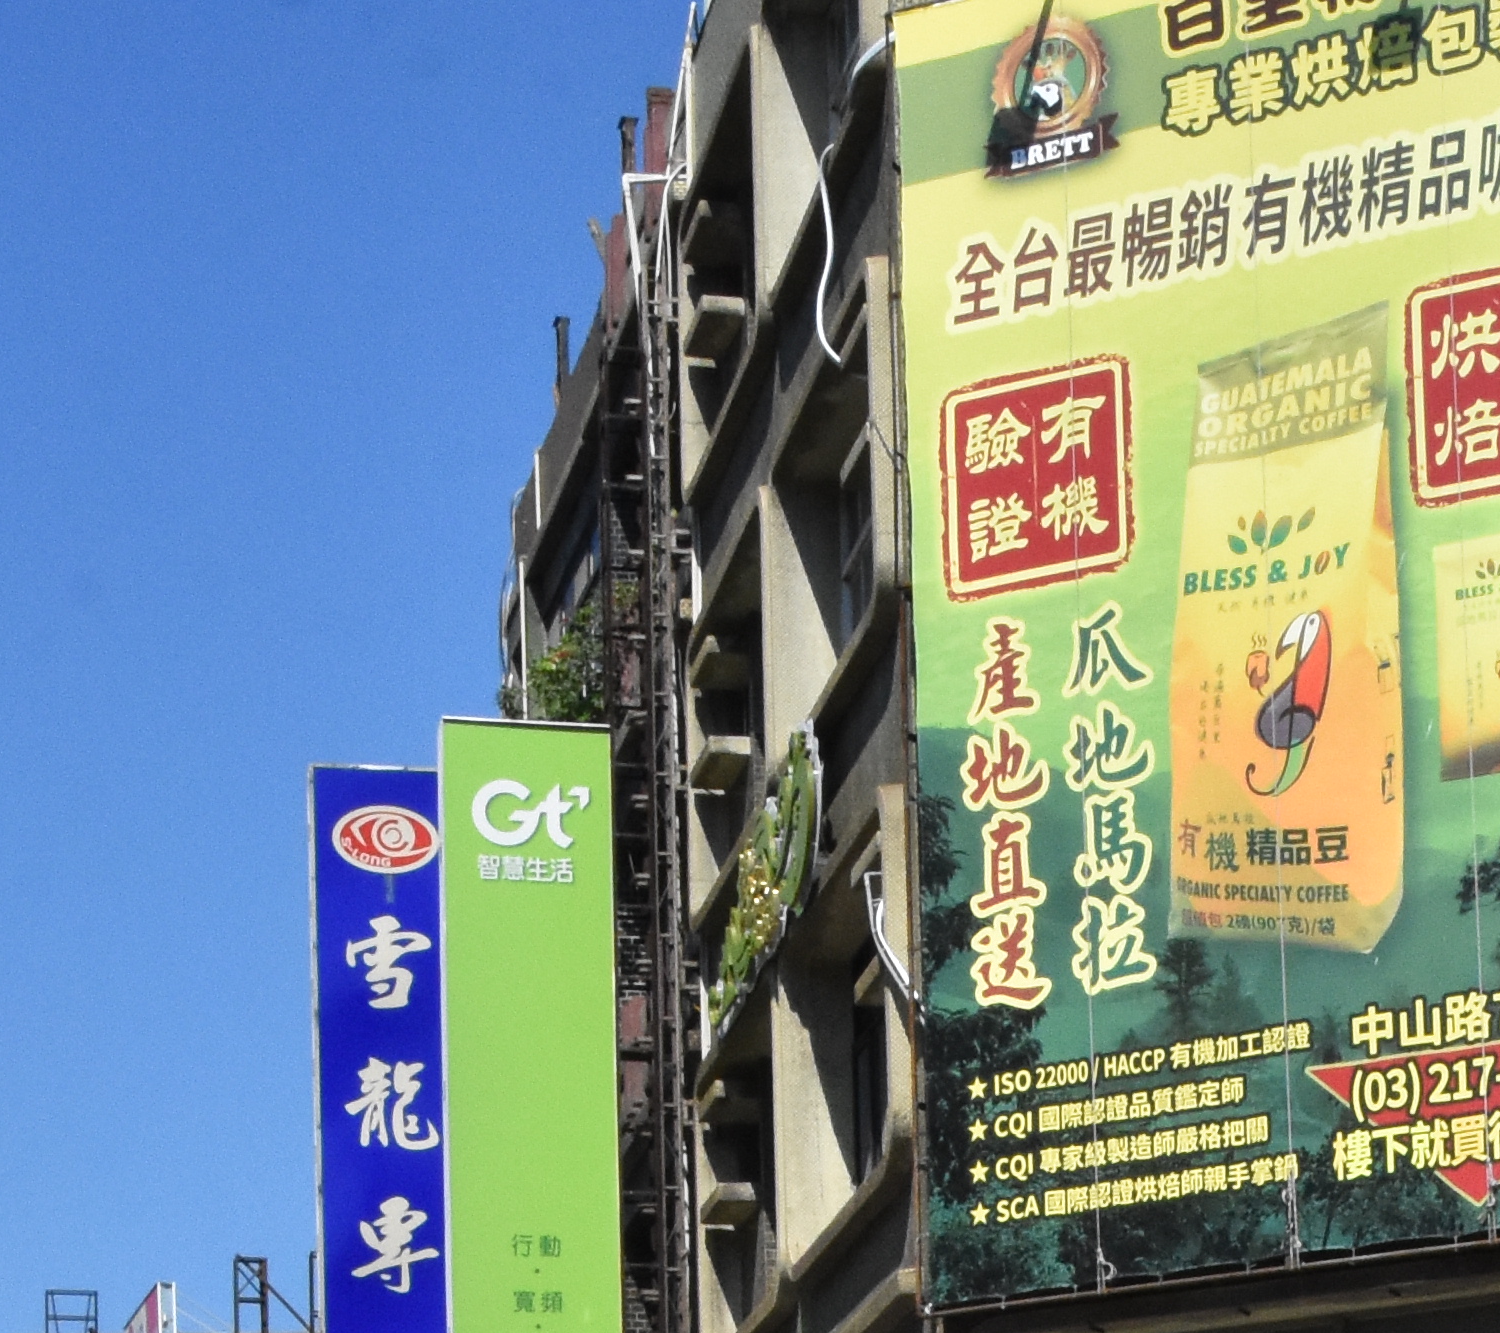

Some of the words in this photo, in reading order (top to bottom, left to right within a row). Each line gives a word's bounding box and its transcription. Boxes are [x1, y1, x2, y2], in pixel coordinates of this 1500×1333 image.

[1010, 132, 1095, 170] BRETT
[1198, 374, 1372, 437] ORGANIC
[1200, 346, 1373, 414] GUATEMALA
[1194, 422, 1290, 457] SPECIALTY
[1299, 402, 1373, 435] COFFEE
[965, 411, 1032, 564] 驗證
[1040, 395, 1110, 539] 有機
[1183, 564, 1258, 596] BLESS
[1267, 555, 1288, 584] &
[1298, 541, 1351, 580] JOY
[1455, 584, 1494, 600] BLESS
[966, 620, 1047, 1005] 產地直送
[1066, 604, 1155, 991] 瓜地馬拉
[341, 836, 392, 867] S-LONG
[476, 853, 575, 885] 智慧生活
[1223, 884, 1292, 903] SPECIALTY
[1297, 884, 1349, 903] COFFEE
[993, 1071, 1032, 1097] ISO
[1035, 1061, 1089, 1090] 22000
[1103, 1049, 1166, 1080] HACCP
[1170, 1022, 1311, 1070] 有機加工認證
[993, 1112, 1033, 1140] CQI
[1038, 1075, 1245, 1132] 國際認證品質鑑定師
[1350, 1065, 1421, 1120] (03)
[995, 1153, 1035, 1182] CQI
[1039, 1114, 1269, 1173] 專家級製造師嚴格把關
[996, 1196, 1040, 1223] SCA
[511, 1233, 563, 1260] 行動
[512, 1290, 565, 1315] 寬頻
